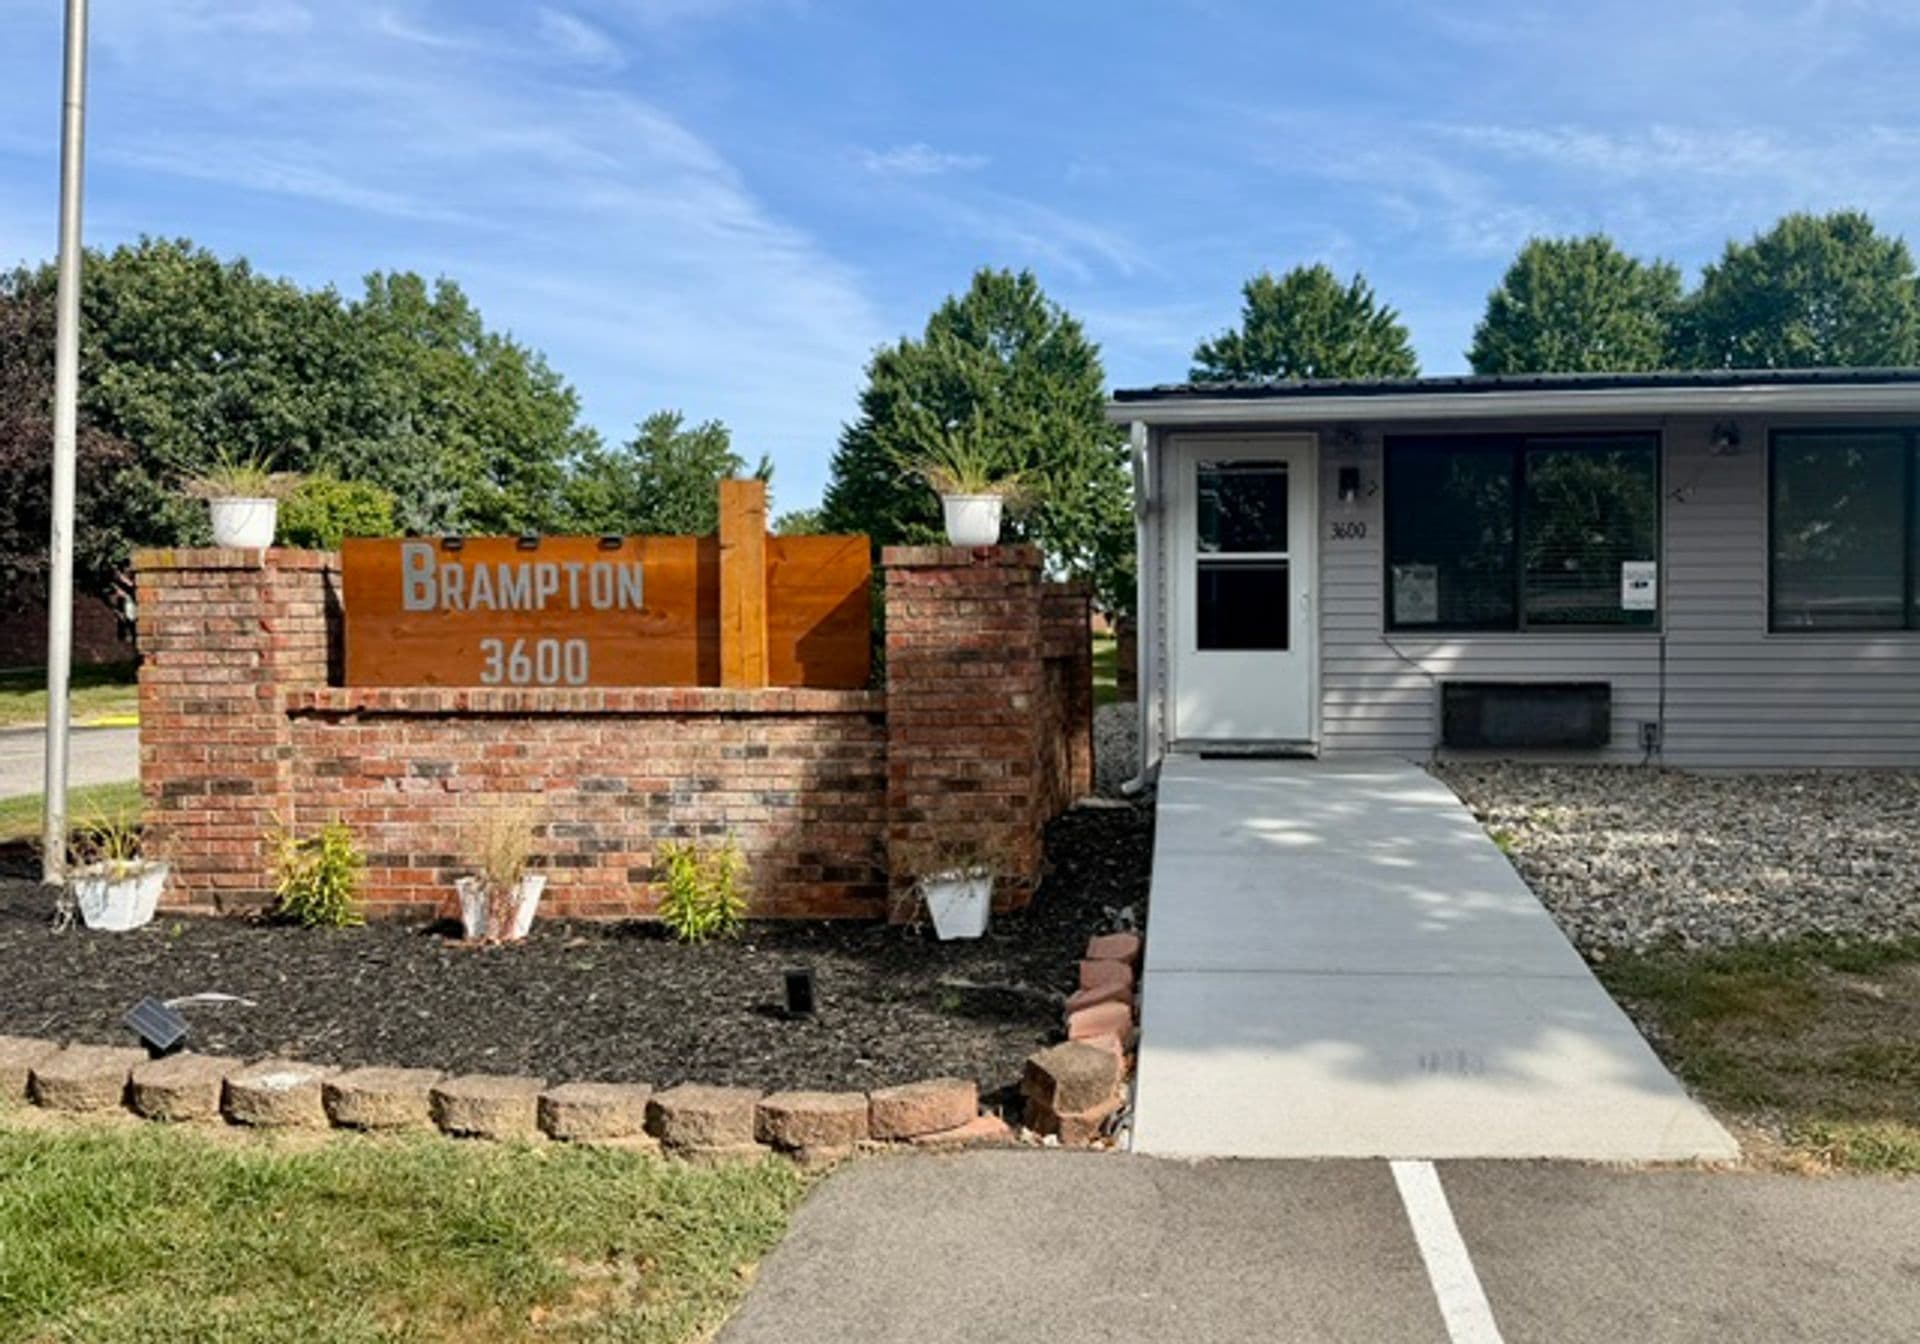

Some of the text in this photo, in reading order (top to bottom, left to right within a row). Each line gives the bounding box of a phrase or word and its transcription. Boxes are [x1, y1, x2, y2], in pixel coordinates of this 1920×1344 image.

[1331, 521, 1367, 540] 3600
[401, 542, 644, 612] BRAMPTON
[479, 638, 589, 685] 3600
